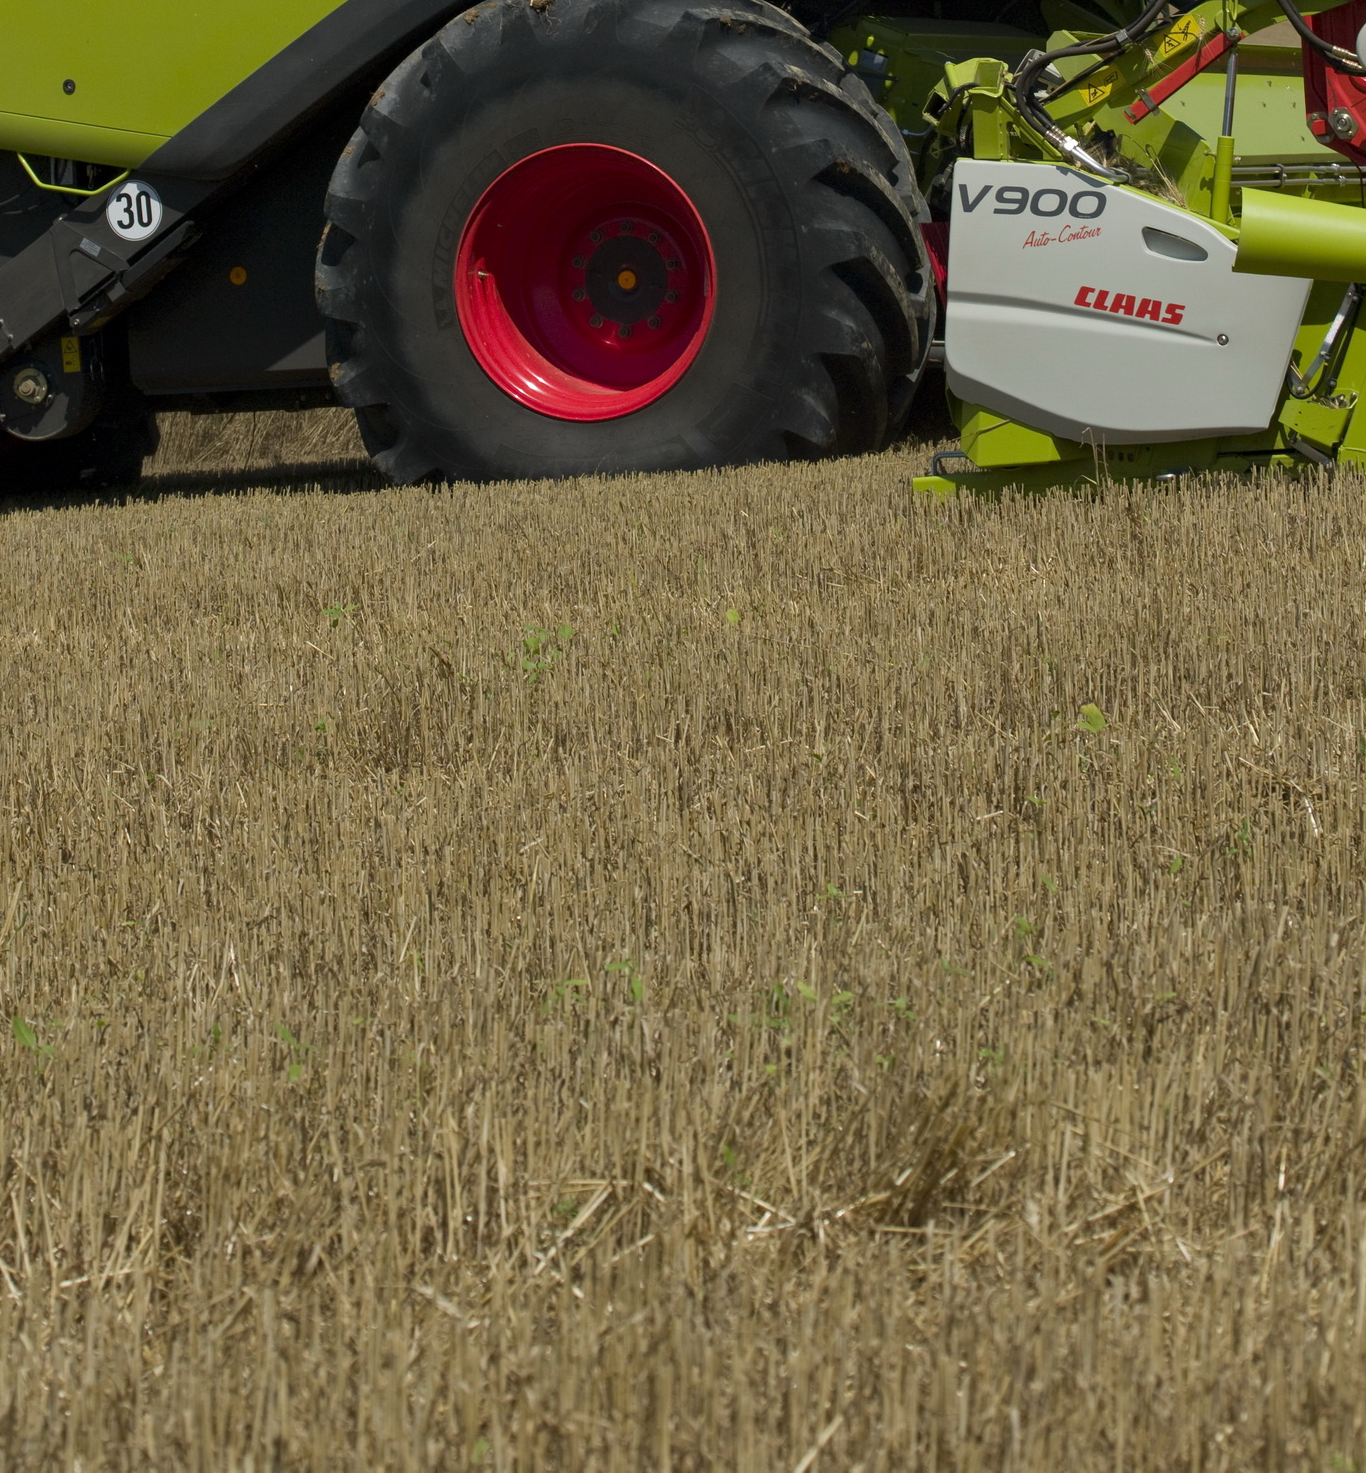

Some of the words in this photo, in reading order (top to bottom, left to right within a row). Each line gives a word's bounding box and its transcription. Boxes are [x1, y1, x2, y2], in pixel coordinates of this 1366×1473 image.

[116, 190, 153, 229] 30
[958, 184, 1107, 219] V900
[1022, 224, 1102, 249] Auto-Contour
[1074, 286, 1186, 325] CLAAS
